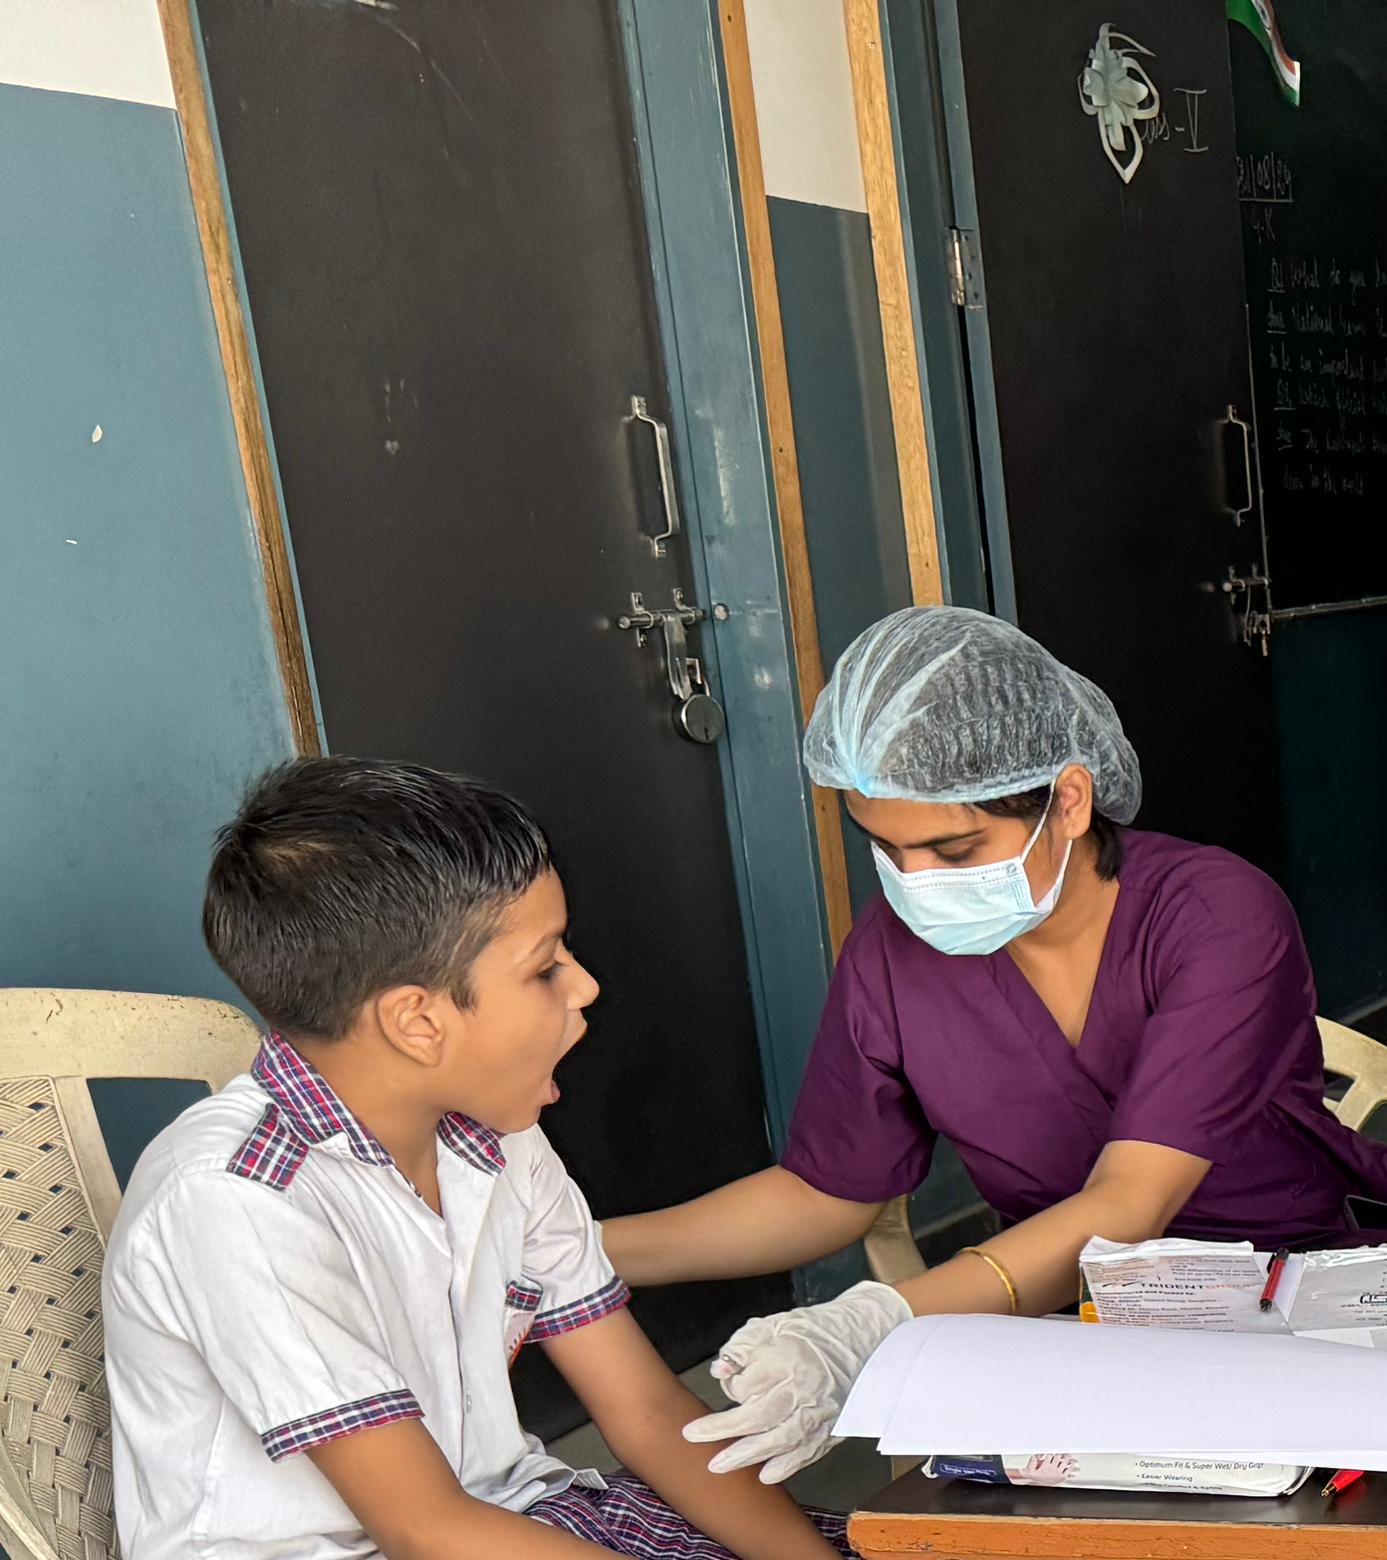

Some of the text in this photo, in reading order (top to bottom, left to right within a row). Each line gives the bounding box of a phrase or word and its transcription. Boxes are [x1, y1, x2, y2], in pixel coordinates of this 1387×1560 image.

[1139, 1460, 1173, 1469] Optimum
[1174, 1461, 1184, 1469] Fit
[1192, 1461, 1213, 1470] Super
[1233, 1462, 1247, 1471] Dry
[1164, 1473, 1194, 1482] Wearing
